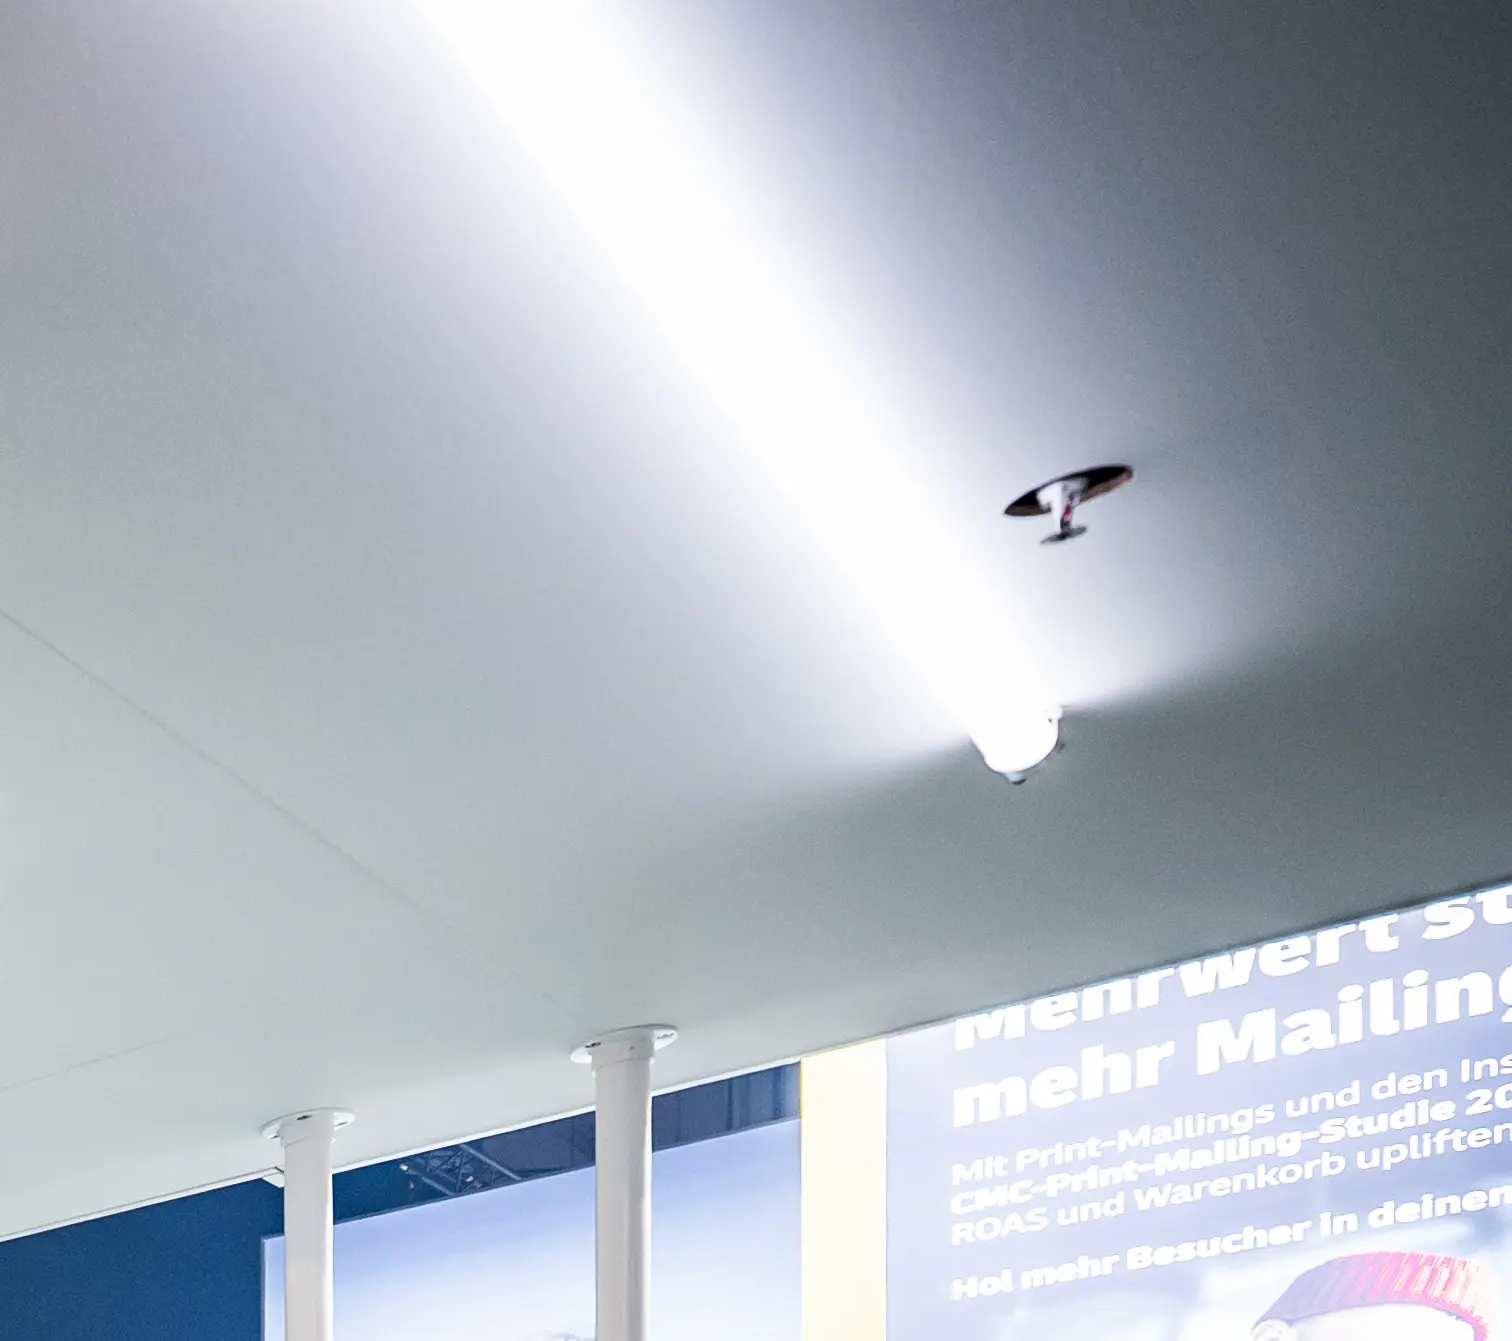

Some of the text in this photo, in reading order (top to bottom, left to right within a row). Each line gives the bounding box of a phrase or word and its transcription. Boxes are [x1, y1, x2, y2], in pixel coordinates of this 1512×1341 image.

[952, 1155, 1009, 1186] Mit
[1016, 1104, 1275, 1173] Print-Mailings
[1285, 1080, 1360, 1117] und
[1371, 1068, 1448, 1100] den
[953, 1041, 1175, 1128] mehr
[950, 1099, 1457, 1215] CMC-Print-Mailing-Studie
[952, 1208, 1049, 1246] ROAS
[1057, 1192, 1125, 1225] und
[1134, 1152, 1346, 1211] Warenkorb
[951, 1269, 1014, 1301] Hol
[1021, 1255, 1119, 1289] mehr
[1127, 1220, 1312, 1271] Besucher
[1320, 1211, 1359, 1237] in
